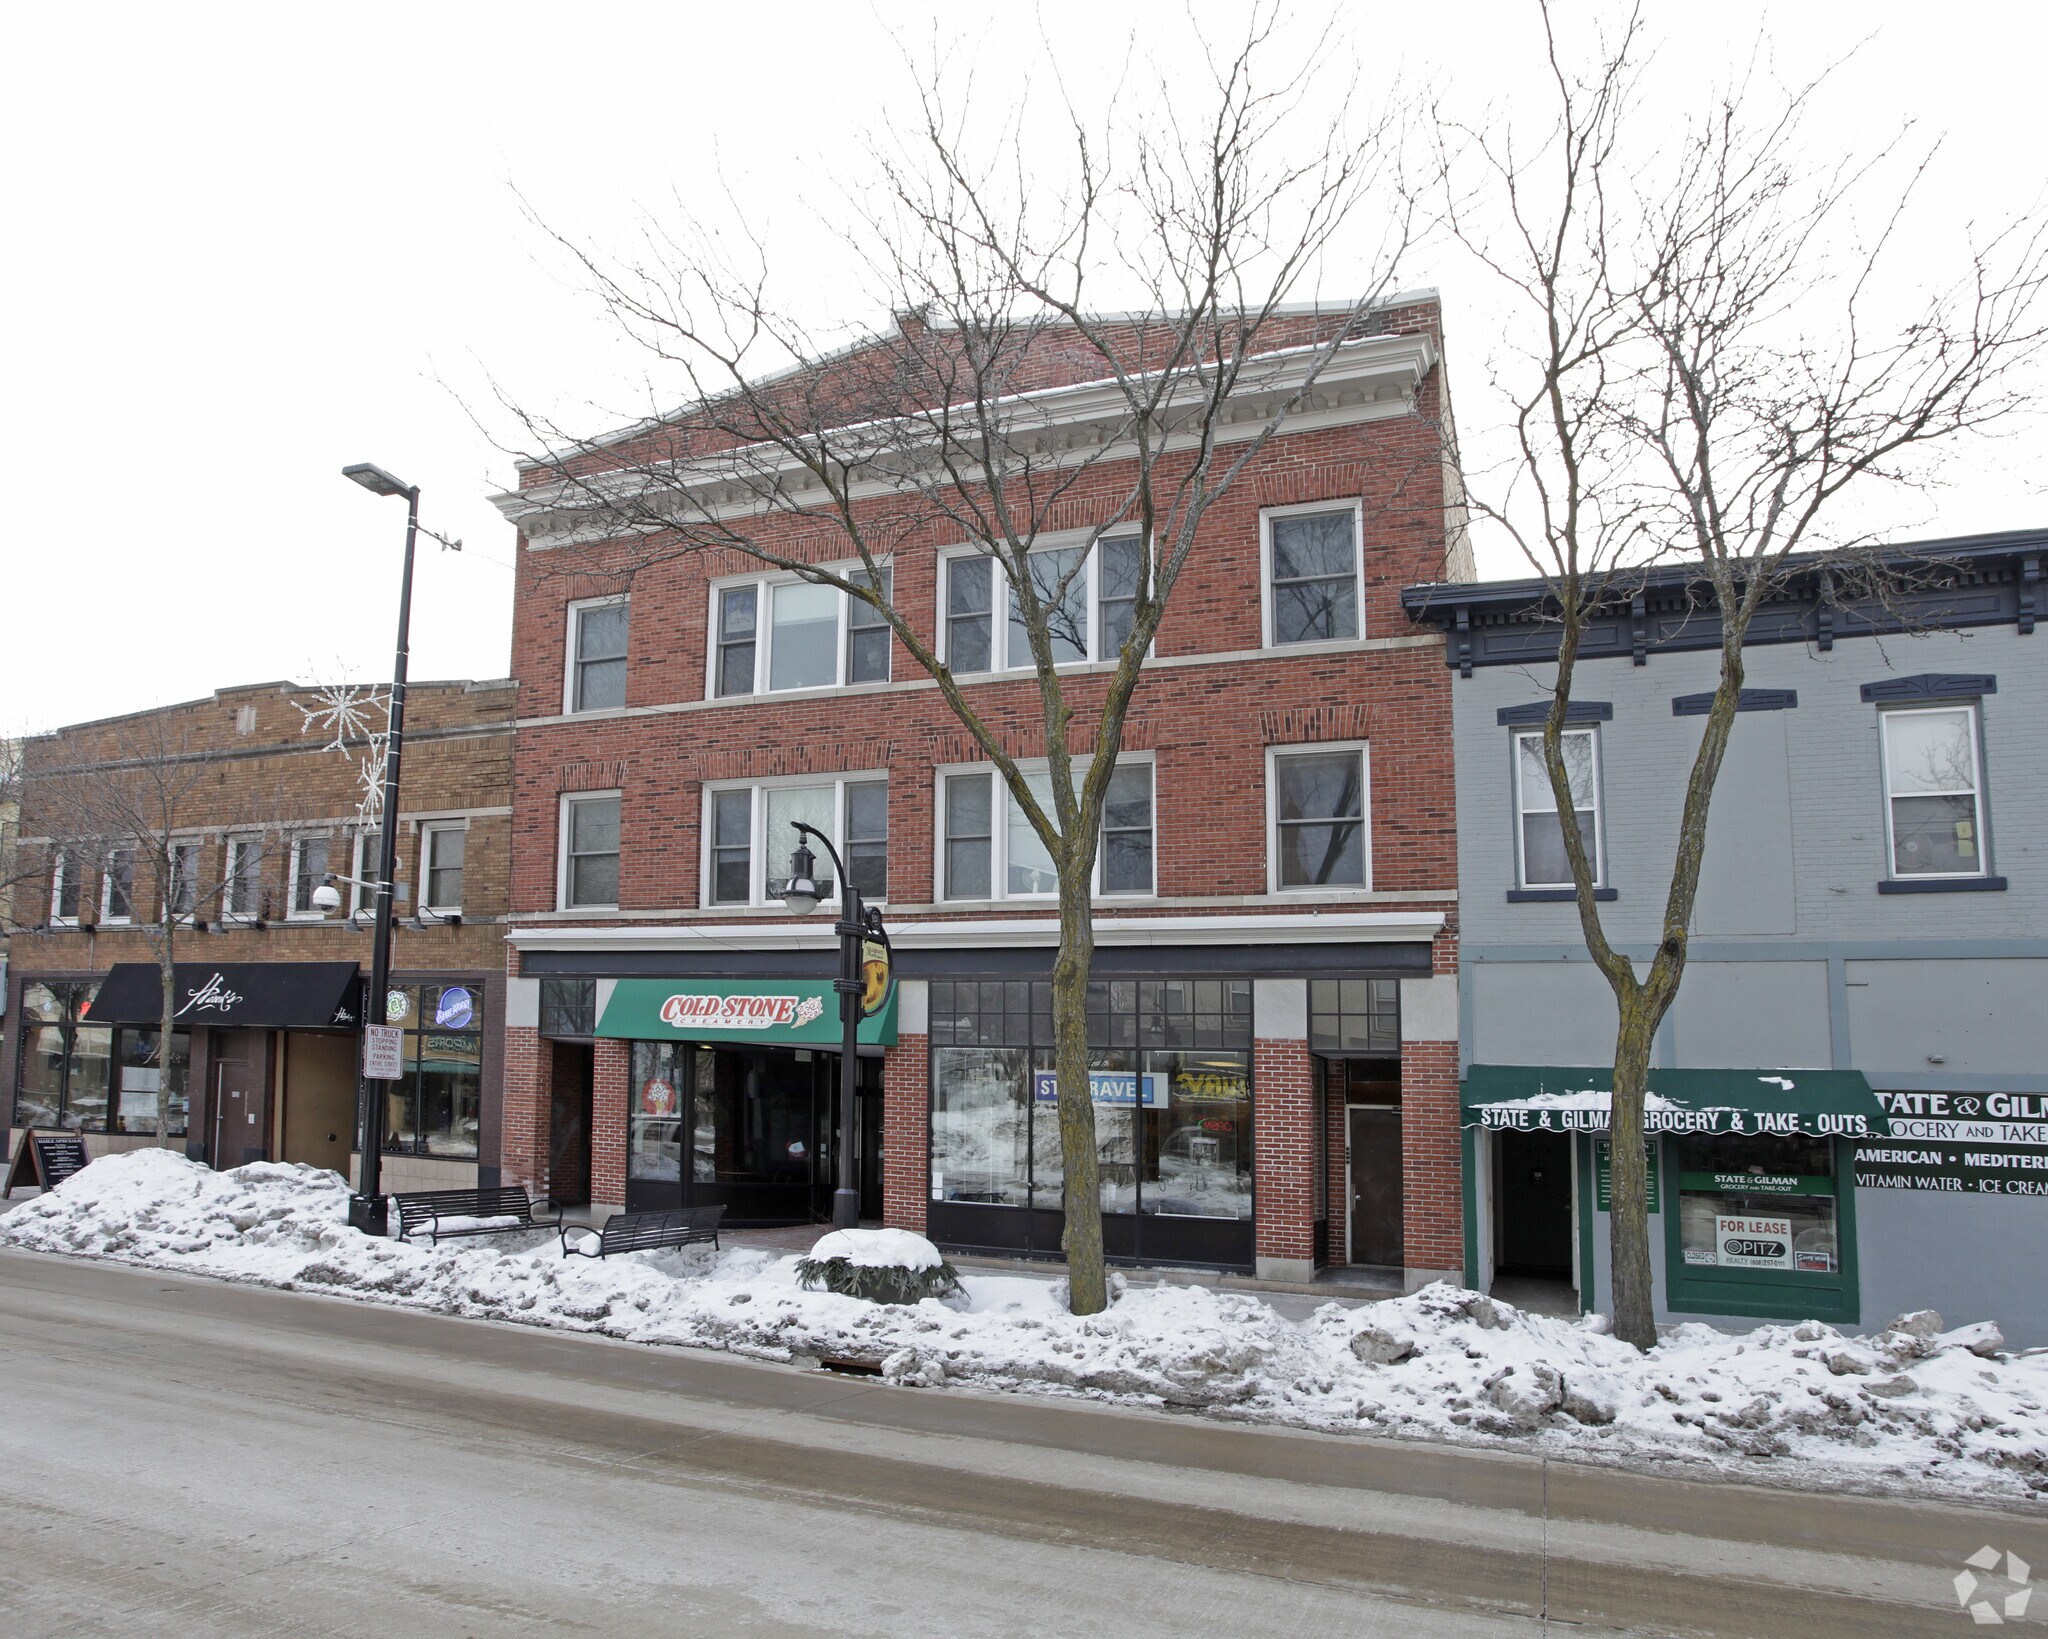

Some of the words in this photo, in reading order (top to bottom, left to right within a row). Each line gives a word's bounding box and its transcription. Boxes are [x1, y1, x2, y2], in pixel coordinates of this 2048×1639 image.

[663, 997, 721, 1020] COLD
[722, 997, 797, 1022] STONE
[381, 1029, 399, 1038] TRUCK
[371, 1044, 397, 1052] STANDING
[1089, 1080, 1148, 1097] RAVE
[1873, 1092, 1950, 1115] TATE
[1953, 1096, 1981, 1116] &
[1481, 1108, 1529, 1126] STATE
[1538, 1110, 1552, 1127] &
[1730, 1112, 1744, 1130] &
[1754, 1112, 1799, 1131] TAKE
[1817, 1113, 1867, 1132] OUTS
[1890, 1120, 1960, 1139] OCERY
[1965, 1126, 1994, 1138] AND
[1854, 1148, 1942, 1165] AMERICAN
[1714, 1174, 1746, 1184] STATE
[1747, 1176, 1754, 1184] &
[1754, 1176, 1798, 1186] GILMAN
[1855, 1173, 1912, 1189] VITAMIN
[1915, 1175, 1963, 1191] WATER
[1979, 1178, 2002, 1194] ICE
[2005, 1179, 2048, 1196] CREA
[1720, 1220, 1745, 1232] FOR
[1749, 1221, 1788, 1234] LEASE
[1726, 1239, 1780, 1255] OPITZ
